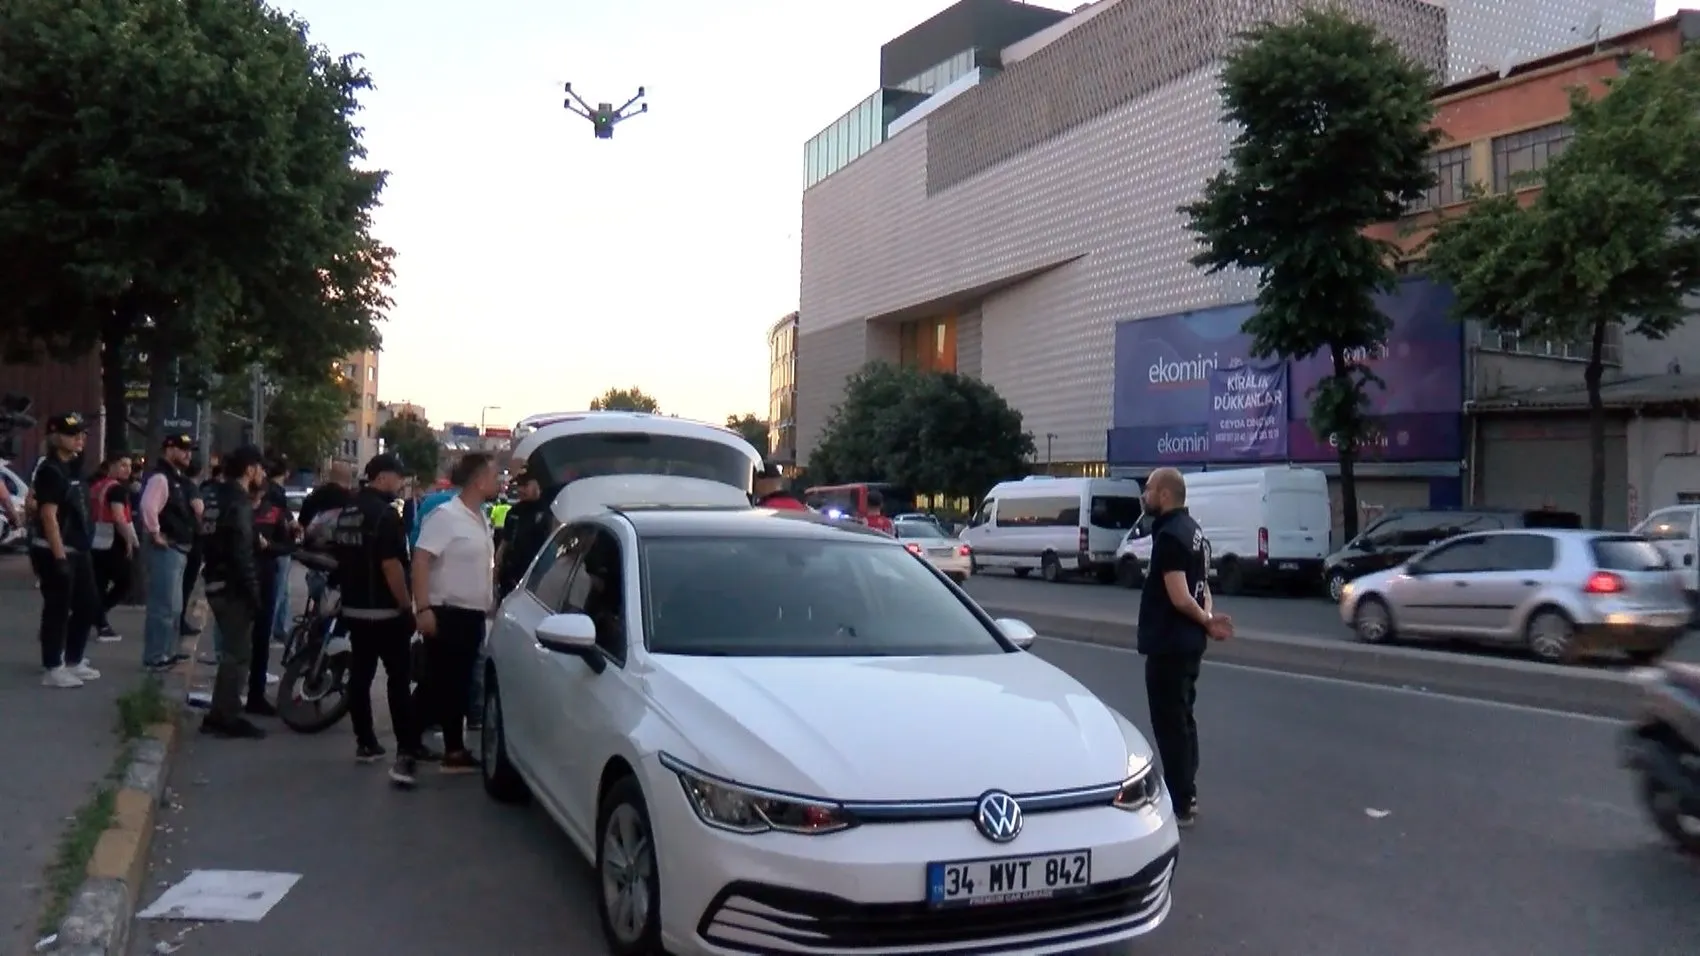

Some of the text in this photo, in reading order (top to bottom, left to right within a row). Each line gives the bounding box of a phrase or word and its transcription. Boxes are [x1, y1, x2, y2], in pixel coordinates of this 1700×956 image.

[1148, 352, 1218, 383] ekomini
[1214, 390, 1283, 411] DÜKKANLAR
[1157, 431, 1209, 454] ekomini
[946, 855, 1086, 896] 34 MVT 842
